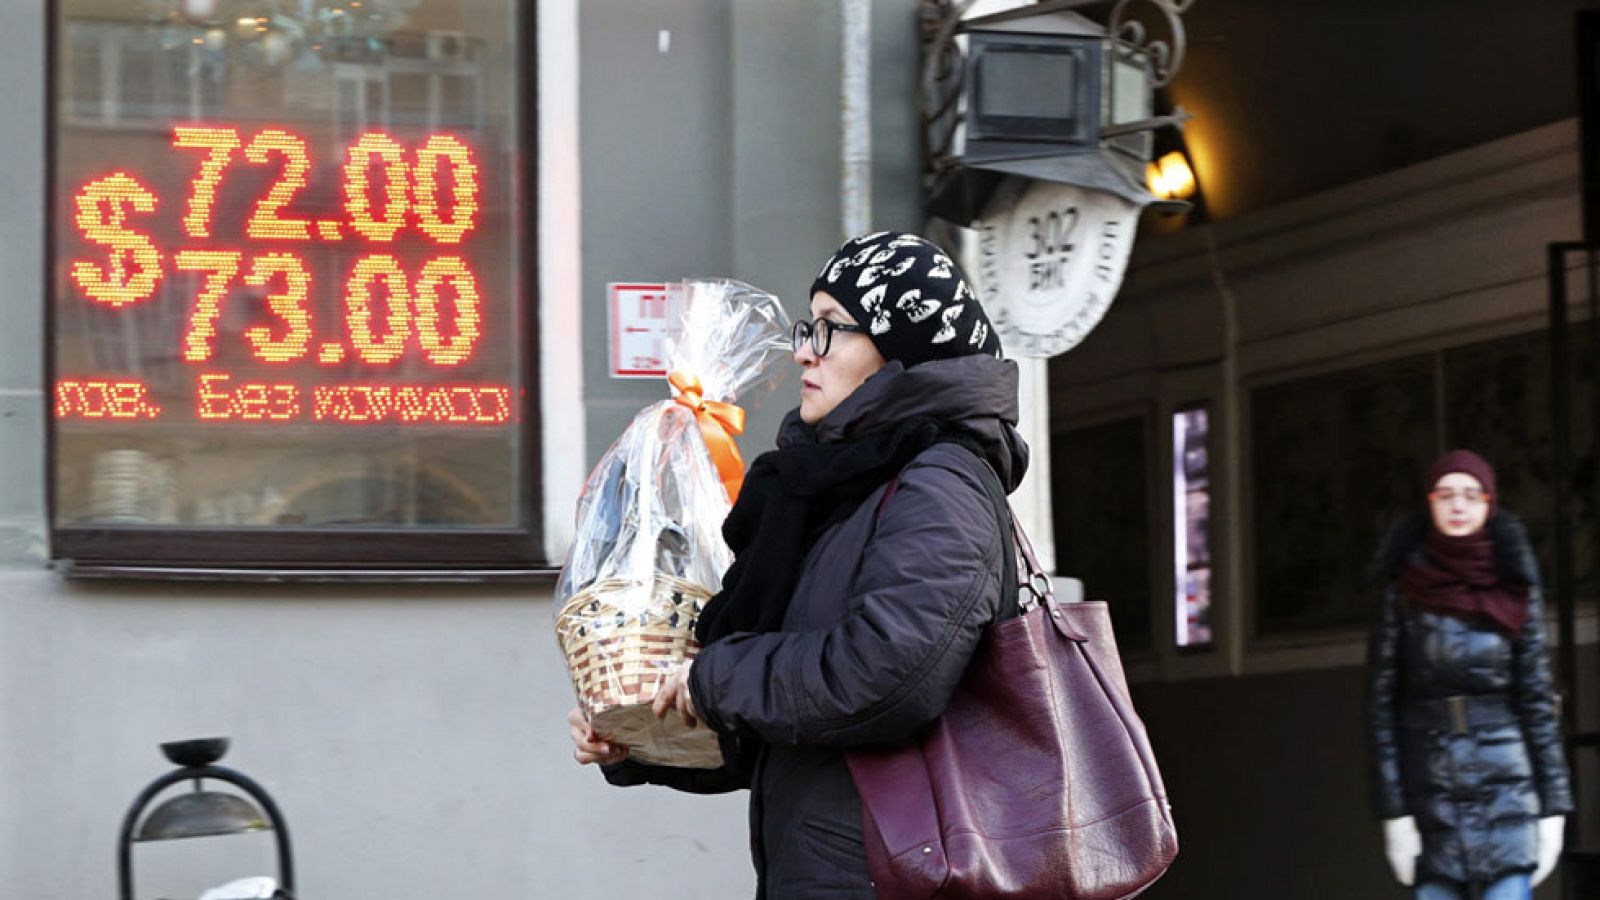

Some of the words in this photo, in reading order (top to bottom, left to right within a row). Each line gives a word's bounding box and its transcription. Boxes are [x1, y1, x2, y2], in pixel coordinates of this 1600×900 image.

[71, 172, 164, 307] $
[172, 126, 479, 243] 72.00
[1025, 206, 1078, 260] 302
[173, 250, 481, 365] 73.00
[198, 373, 300, 419] Без
